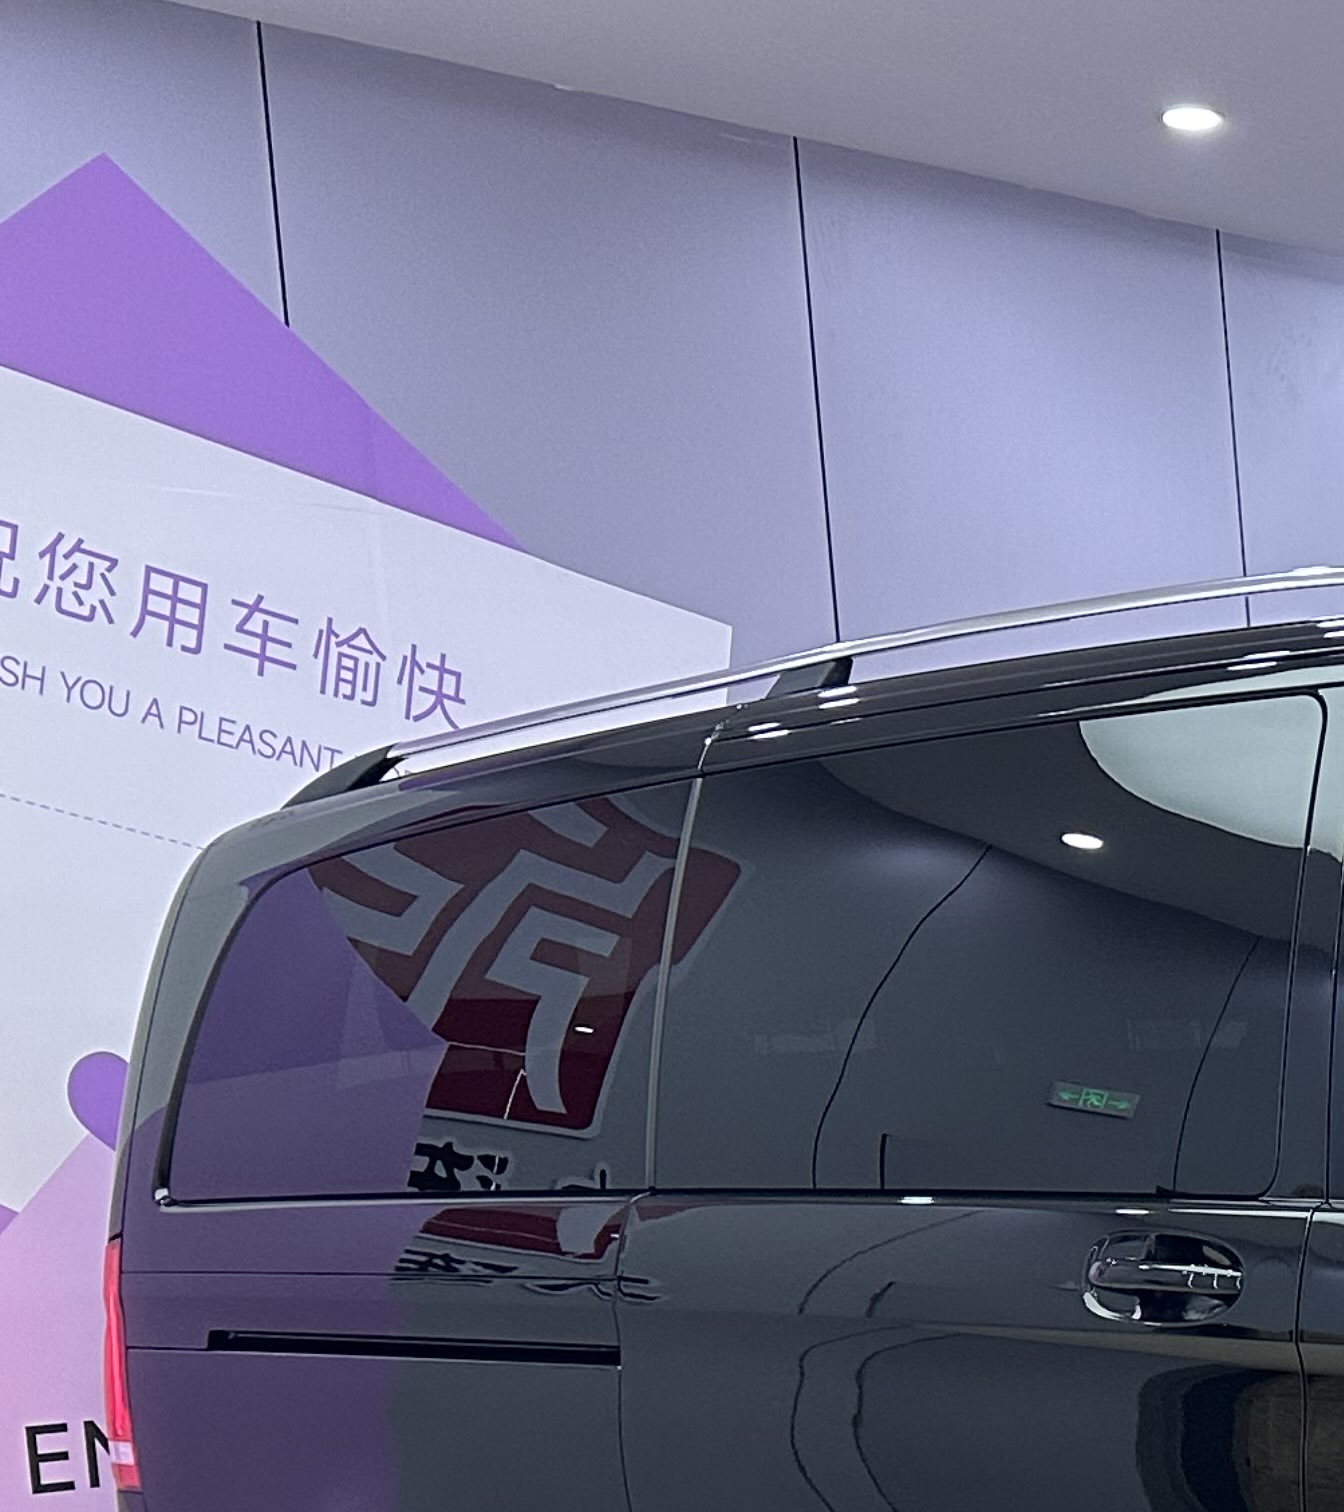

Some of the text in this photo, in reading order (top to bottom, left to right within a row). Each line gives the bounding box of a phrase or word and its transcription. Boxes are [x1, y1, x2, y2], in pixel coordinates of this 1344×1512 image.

[0, 520, 466, 730] 您用车愉快
[60, 671, 131, 718] YOU
[141, 697, 164, 730] A
[177, 706, 343, 774] PLEASANT
